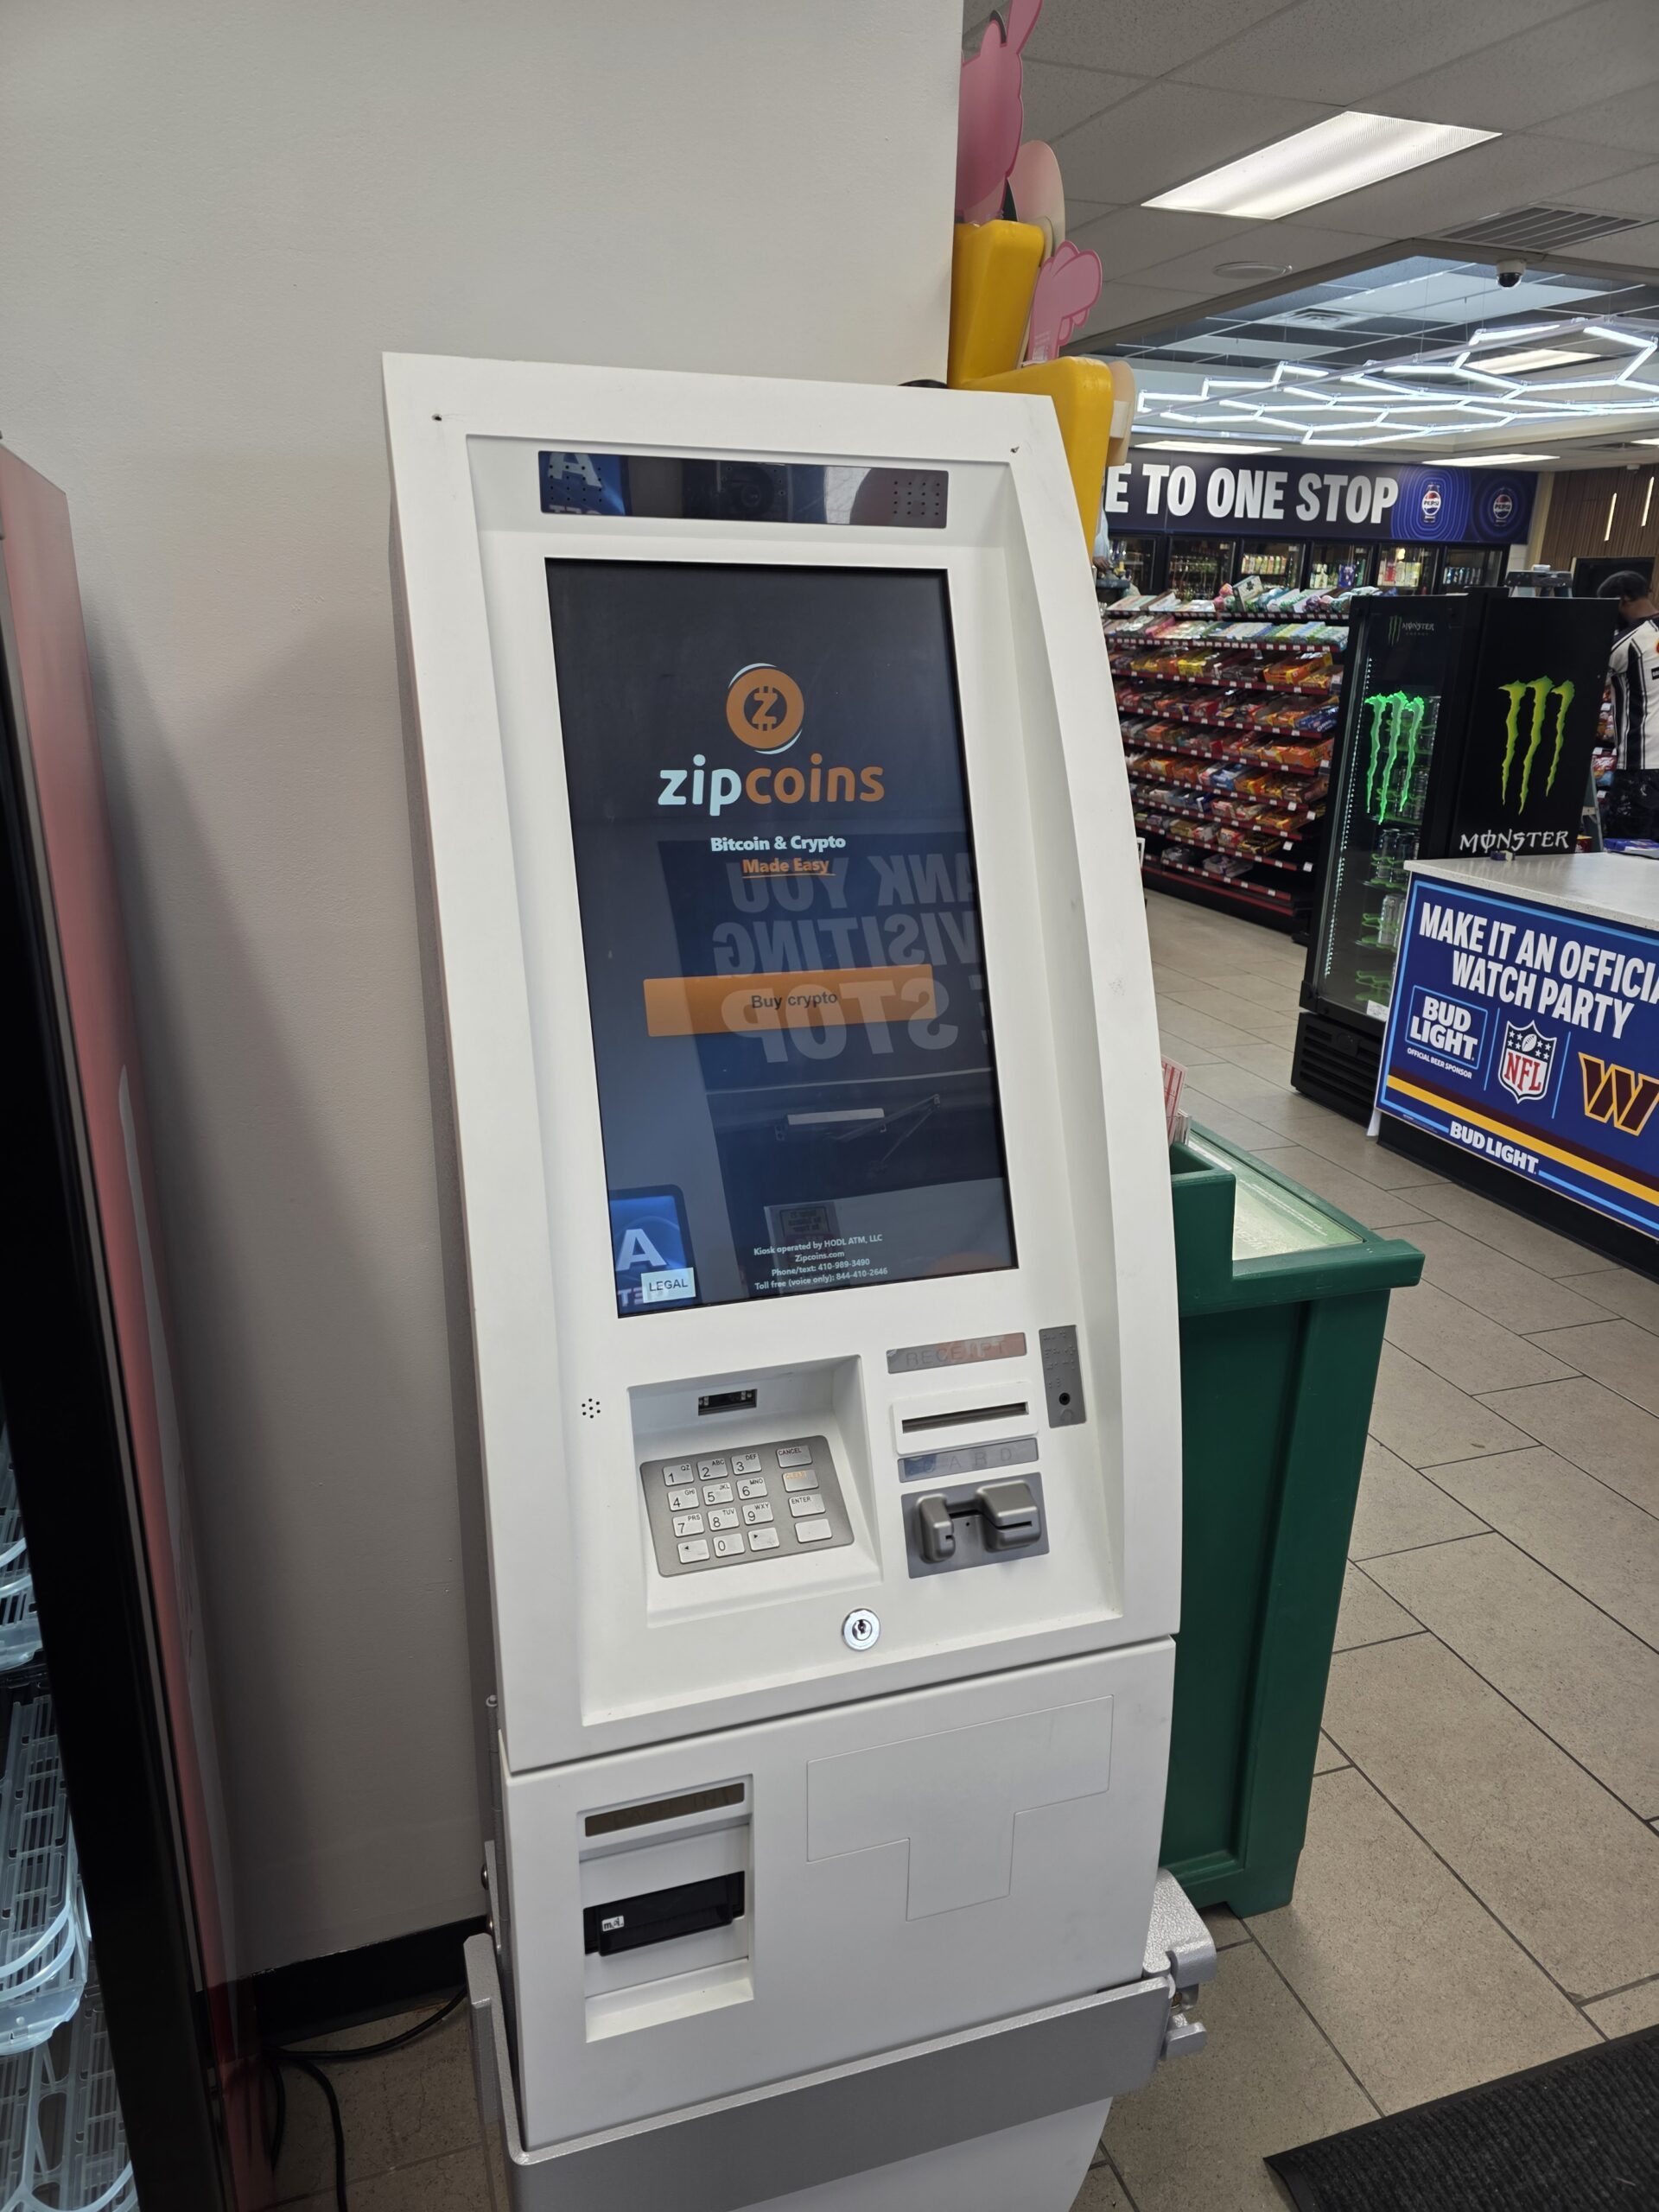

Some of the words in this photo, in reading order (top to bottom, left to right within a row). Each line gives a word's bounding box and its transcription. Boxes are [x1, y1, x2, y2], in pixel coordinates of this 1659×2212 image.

[1104, 463, 1132, 513] E
[1142, 463, 1197, 517] TO
[1206, 467, 1288, 519] ONE
[1296, 473, 1399, 524] STOP
[1402, 621, 1434, 631] MONSTER
[658, 753, 885, 817] zipcoins
[710, 836, 770, 852] Bitcoin
[773, 836, 787, 849] &
[791, 836, 846, 853] Crypto
[1459, 829, 1569, 854] MONSTER
[742, 859, 789, 874] Made
[793, 858, 830, 874] Easy
[1419, 902, 1487, 953] MAKE
[1488, 920, 1516, 960] IT
[1515, 930, 1557, 973] AN
[751, 995, 782, 1010] Buy
[787, 991, 837, 1007] crypto
[1452, 950, 1537, 1010] WATCH
[1538, 976, 1635, 1039] PARTY
[1422, 995, 1471, 1033] BUD
[1410, 1015, 1478, 1061] LIGHT
[1407, 1047, 1430, 1063] OFFICIAL
[1430, 1056, 1445, 1068] BEER
[1445, 1061, 1472, 1079] SPONSOR
[1504, 1051, 1541, 1092] NFL
[1450, 1121, 1485, 1149] BUD
[1485, 1137, 1539, 1174] LIGHT
[753, 1246, 775, 1255] Kiosk
[776, 1242, 810, 1254] operated
[812, 1239, 823, 1250] by
[824, 1237, 847, 1247] HODL
[848, 1236, 868, 1245] ATM,
[869, 1234, 883, 1243] LLC
[795, 1250, 844, 1264] Zipcoins.com
[772, 1264, 817, 1277] Phone/text:
[817, 1258, 870, 1271] 410-989-3490
[649, 1278, 688, 1292] LEGAL
[754, 1281, 769, 1290] Toll
[771, 1278, 786, 1288] free
[788, 1276, 810, 1287] (voice
[812, 1274, 836, 1285] only):
[836, 1268, 888, 1281] 844-410-2646
[906, 1340, 1008, 1366] RECEIPT
[778, 1447, 802, 1456] CANCEL
[702, 1467, 711, 1478] 2
[736, 1461, 745, 1471] 3
[668, 1472, 675, 1483] 1
[707, 1491, 715, 1502] 5
[742, 1486, 751, 1497] 6
[673, 1497, 681, 1508] 4
[791, 1496, 811, 1504] ENTER
[713, 1516, 721, 1528] 8
[747, 1510, 756, 1521] 9
[677, 1522, 685, 1534] 7
[717, 1540, 726, 1551] 0
